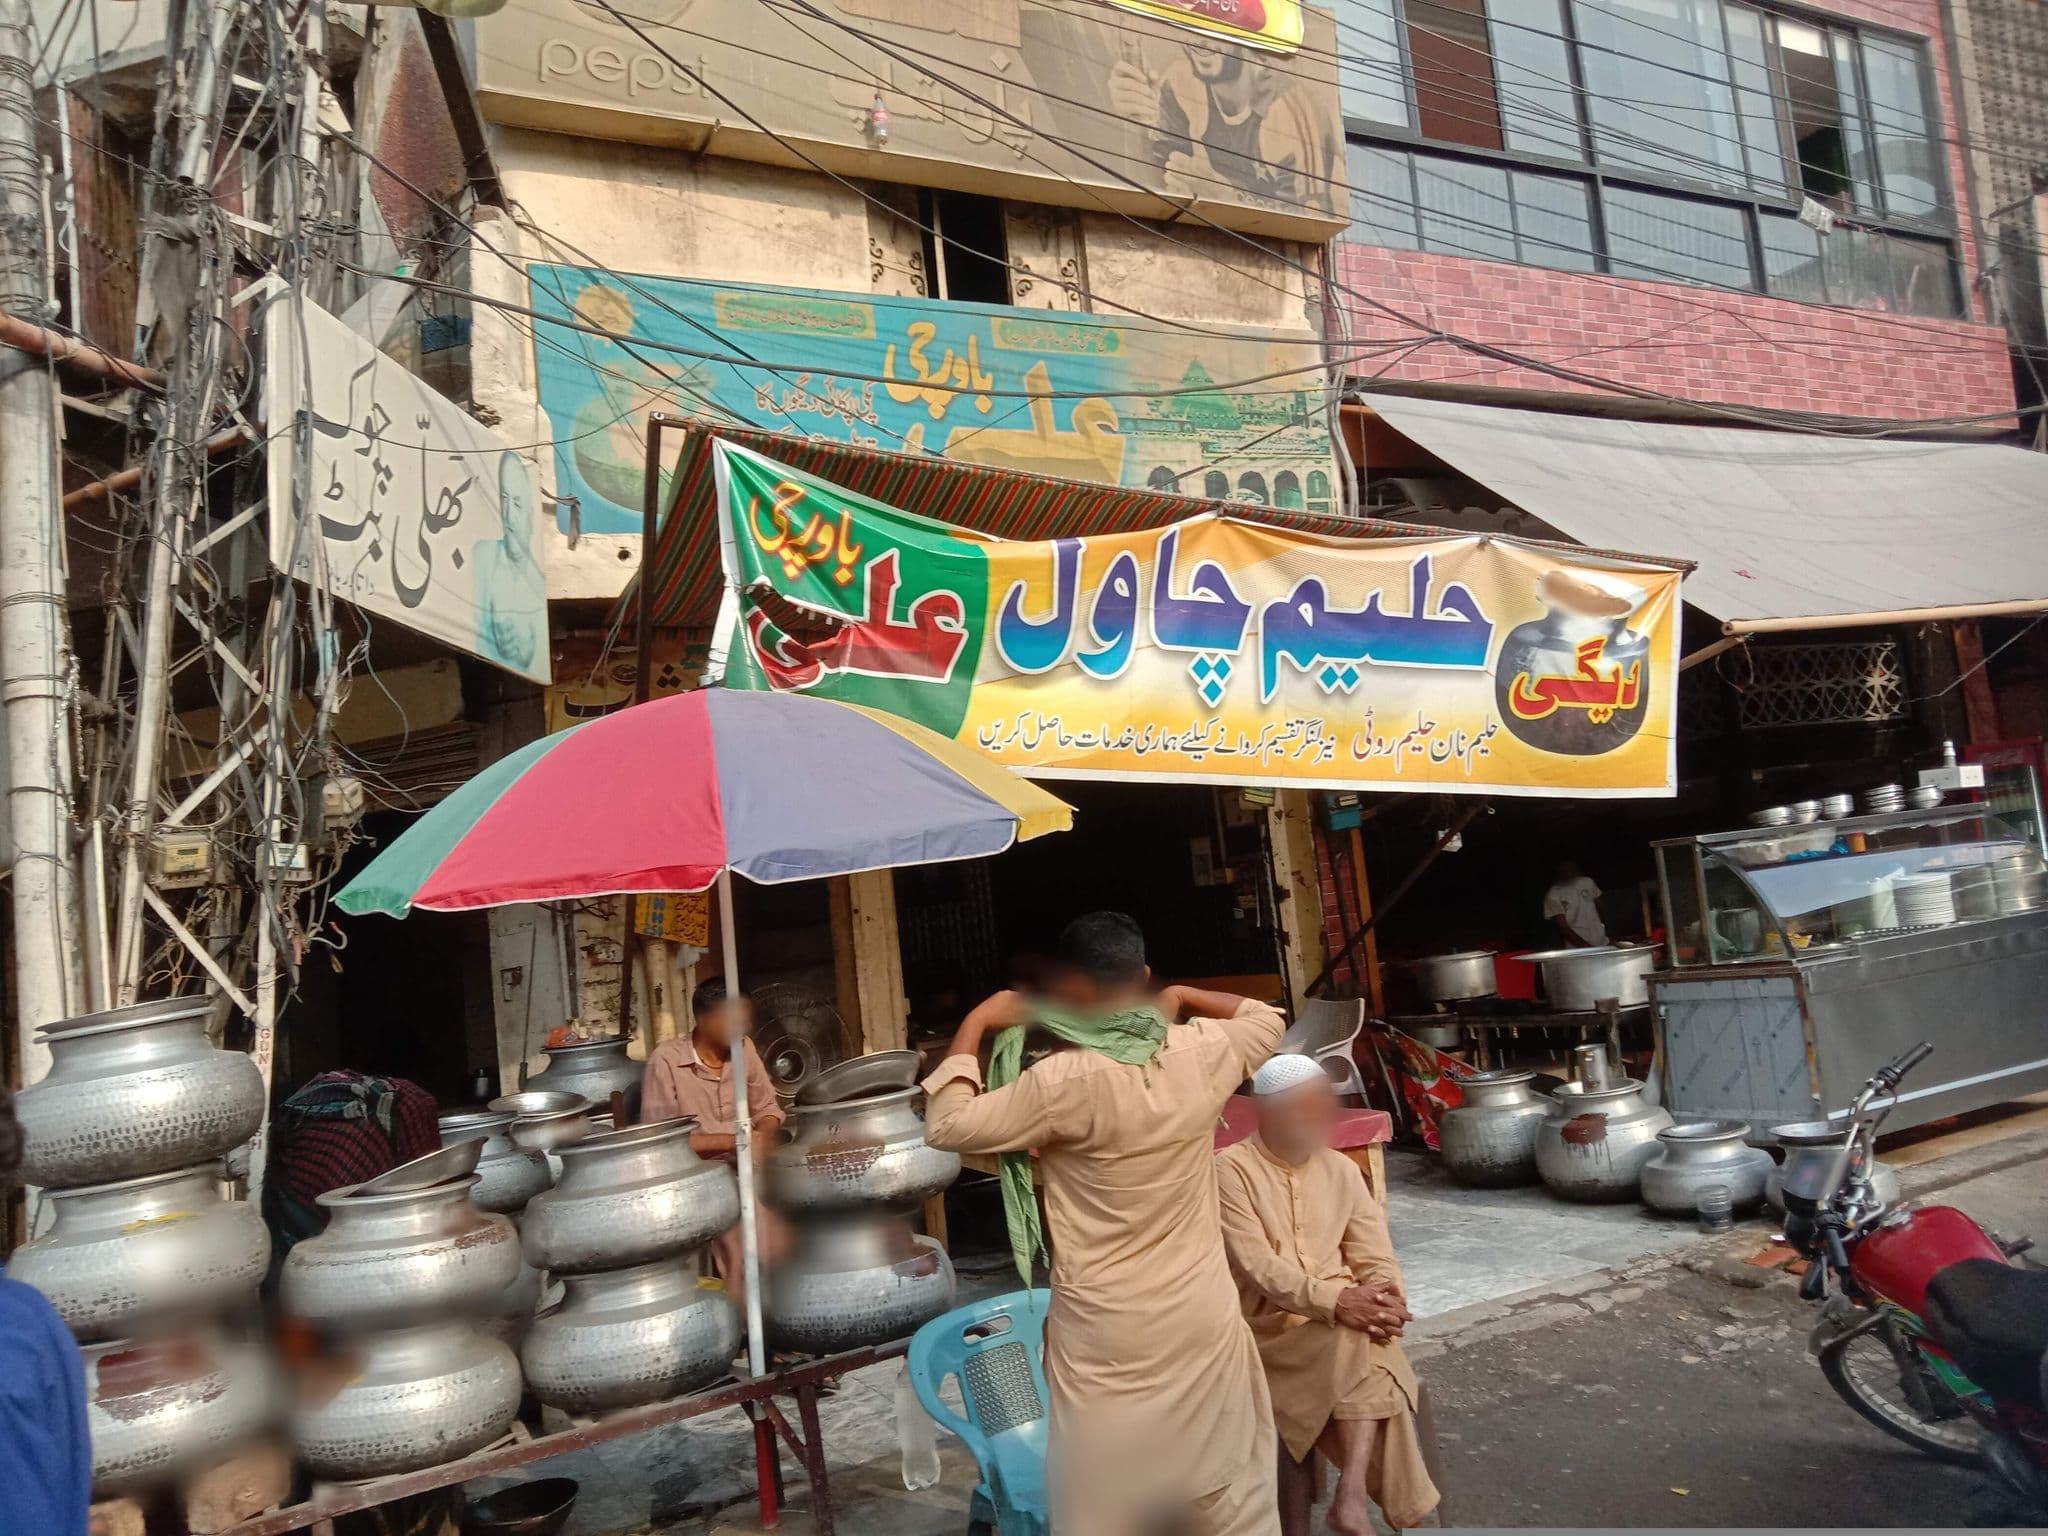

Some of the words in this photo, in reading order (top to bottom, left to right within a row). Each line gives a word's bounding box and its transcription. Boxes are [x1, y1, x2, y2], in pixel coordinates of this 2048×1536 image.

[538, 38, 711, 99] pepsi
[884, 320, 997, 421] باورچی
[903, 360, 1126, 487] عل
[750, 480, 863, 587] باورچی
[741, 547, 970, 692] علی
[997, 525, 1253, 707] چاول
[1258, 552, 1496, 704] حلیم
[1509, 634, 1642, 725] دیگی
[977, 710, 1032, 752] کریں
[1021, 713, 1074, 750] حاصل
[1073, 725, 1137, 750] خدمات
[1134, 724, 1180, 756] ہماری
[1262, 718, 1305, 767] تقسیم
[1291, 717, 1324, 759] لنگر
[1313, 735, 1337, 766] نیز
[1352, 705, 1397, 761] روٹی
[1394, 709, 1437, 774] حلیم
[1430, 728, 1467, 763] نان
[1464, 713, 1500, 776] حلیم
